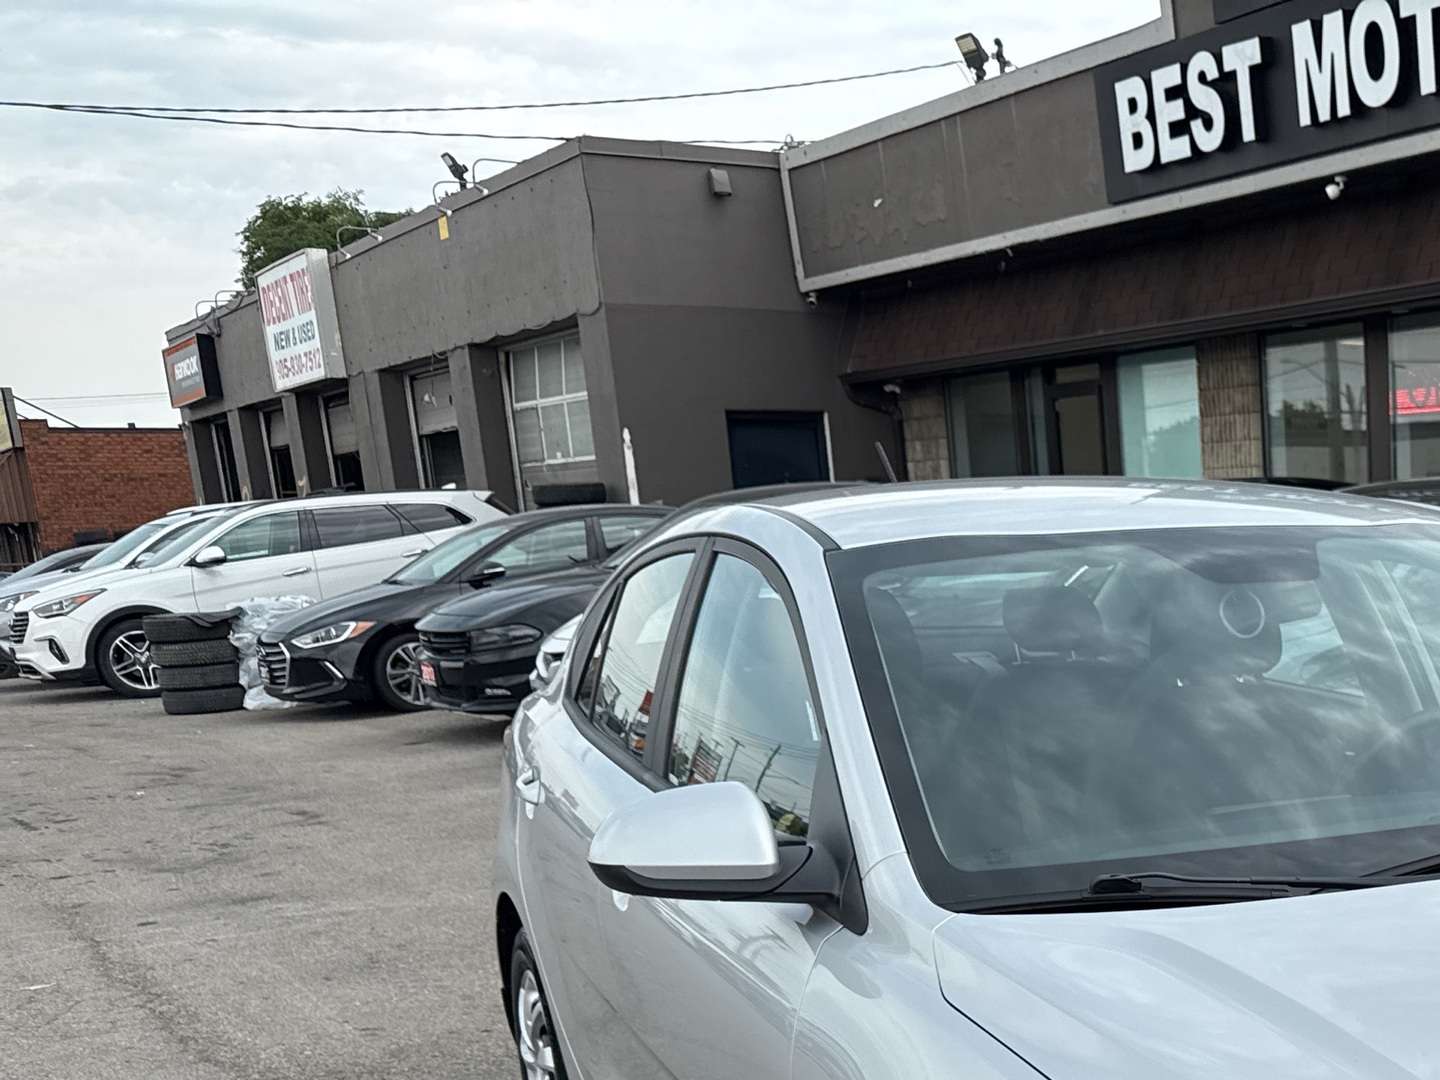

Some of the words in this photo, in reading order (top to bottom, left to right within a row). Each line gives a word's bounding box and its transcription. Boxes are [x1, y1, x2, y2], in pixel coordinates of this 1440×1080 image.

[1114, 36, 1263, 174] BEST
[261, 275, 294, 327] DECENT
[273, 330, 291, 350] NEW
[292, 327, 298, 346] &
[298, 320, 316, 344] USED
